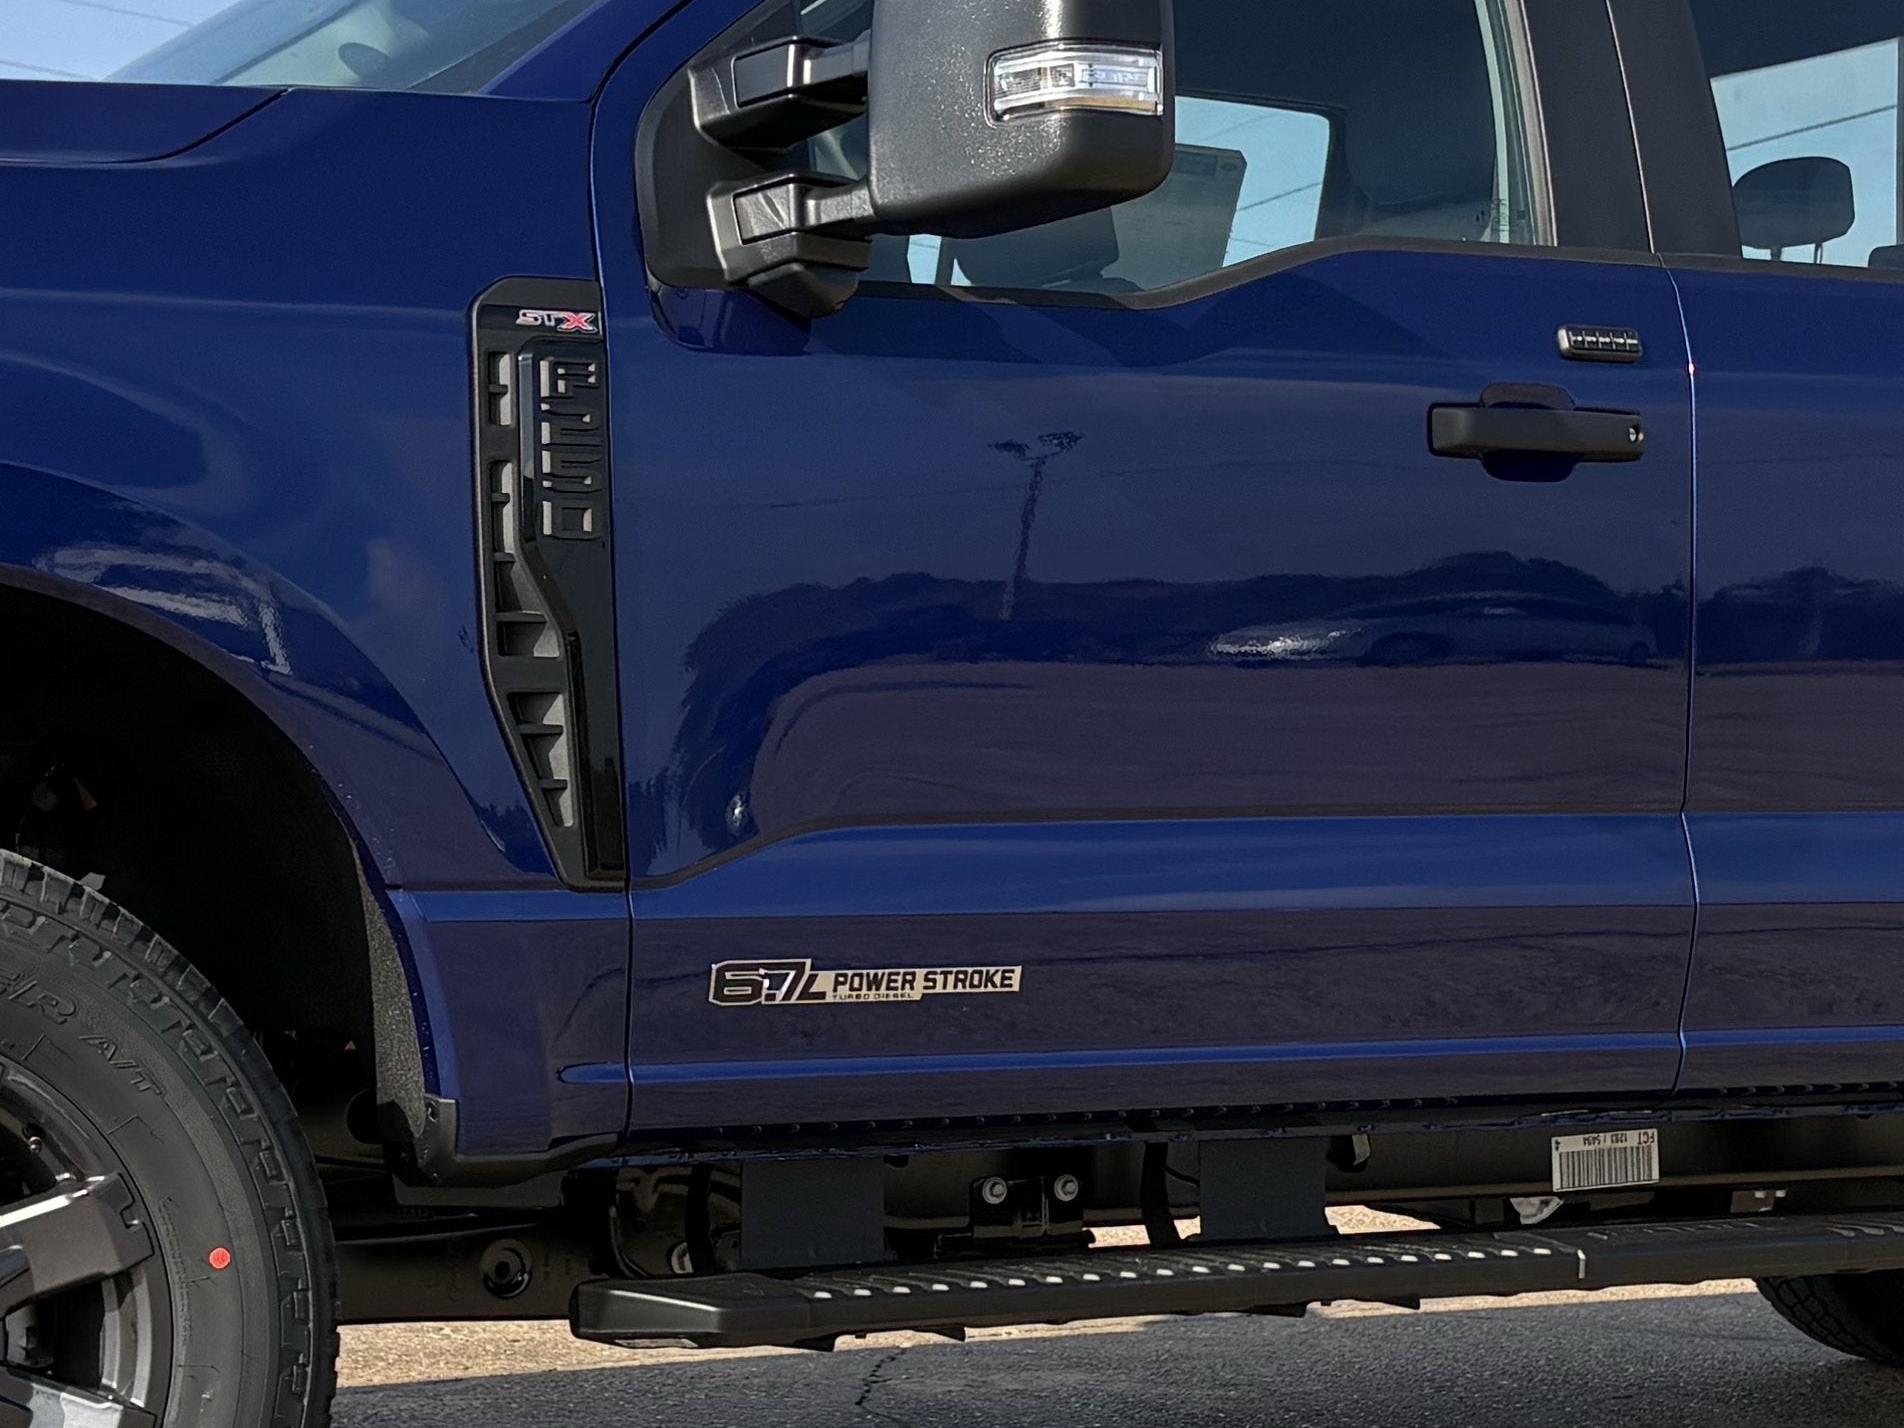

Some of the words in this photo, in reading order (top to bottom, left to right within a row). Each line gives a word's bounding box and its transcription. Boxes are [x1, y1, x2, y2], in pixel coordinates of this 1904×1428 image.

[516, 309, 598, 333] STX
[540, 356, 600, 539] F250
[709, 959, 827, 1006] 6.7L
[832, 971, 918, 993] POWER
[923, 968, 1015, 991] STROKE
[873, 991, 915, 1000] DIESEL
[78, 1033, 164, 1097] A/T
[1637, 1131, 1655, 1145] FCT
